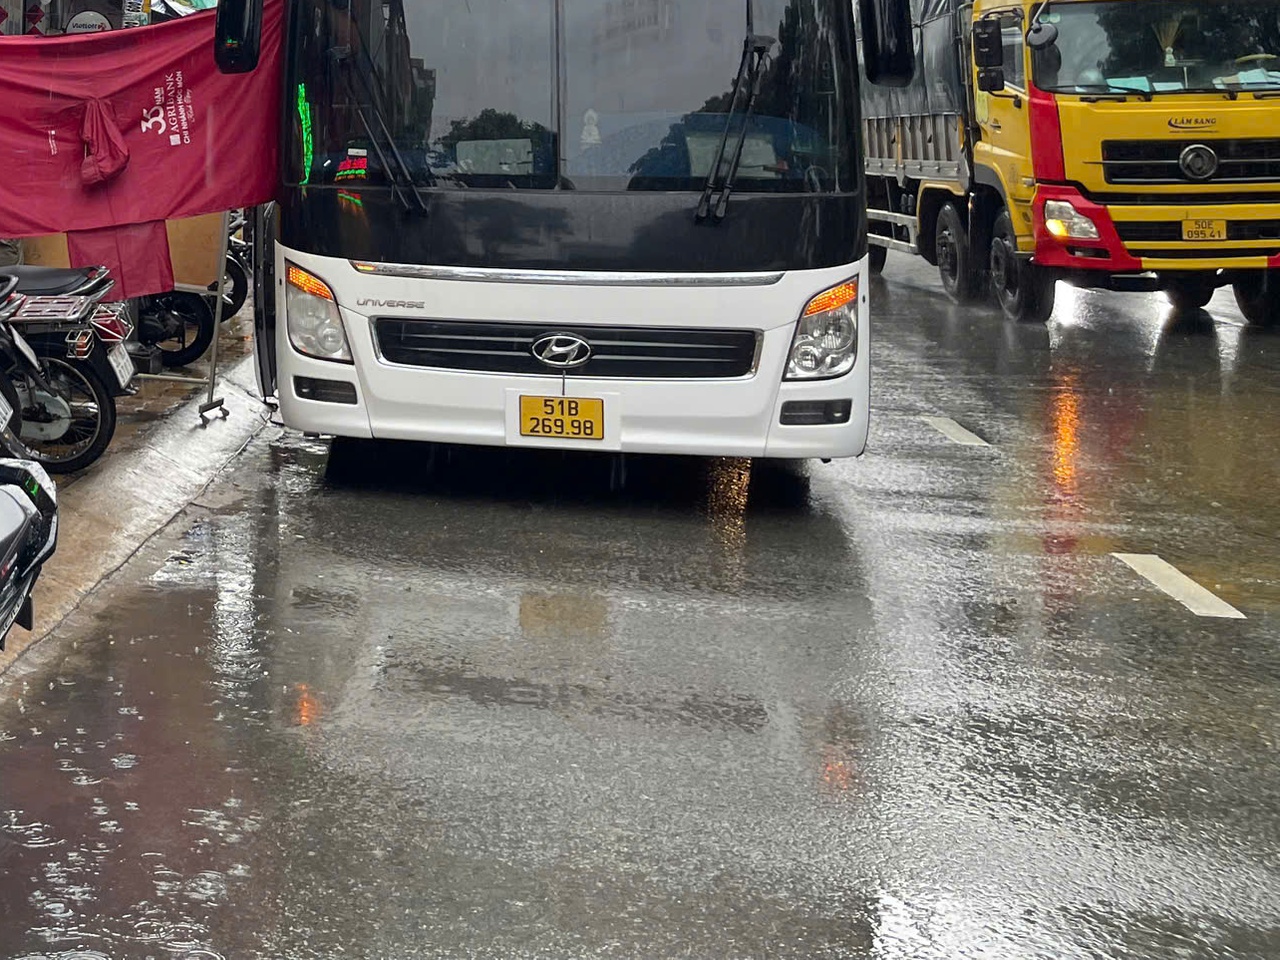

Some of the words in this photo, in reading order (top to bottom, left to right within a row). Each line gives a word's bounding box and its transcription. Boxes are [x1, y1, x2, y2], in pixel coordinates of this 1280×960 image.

[166, 73, 181, 132] AGRIBANK
[141, 106, 166, 134] 35
[1194, 117, 1217, 125] SANG
[183, 130, 191, 144] CHI
[1187, 230, 1221, 239] 095.41
[356, 298, 425, 309] UNIVERSE
[543, 399, 579, 416] 51B
[529, 417, 594, 436] 269.98
